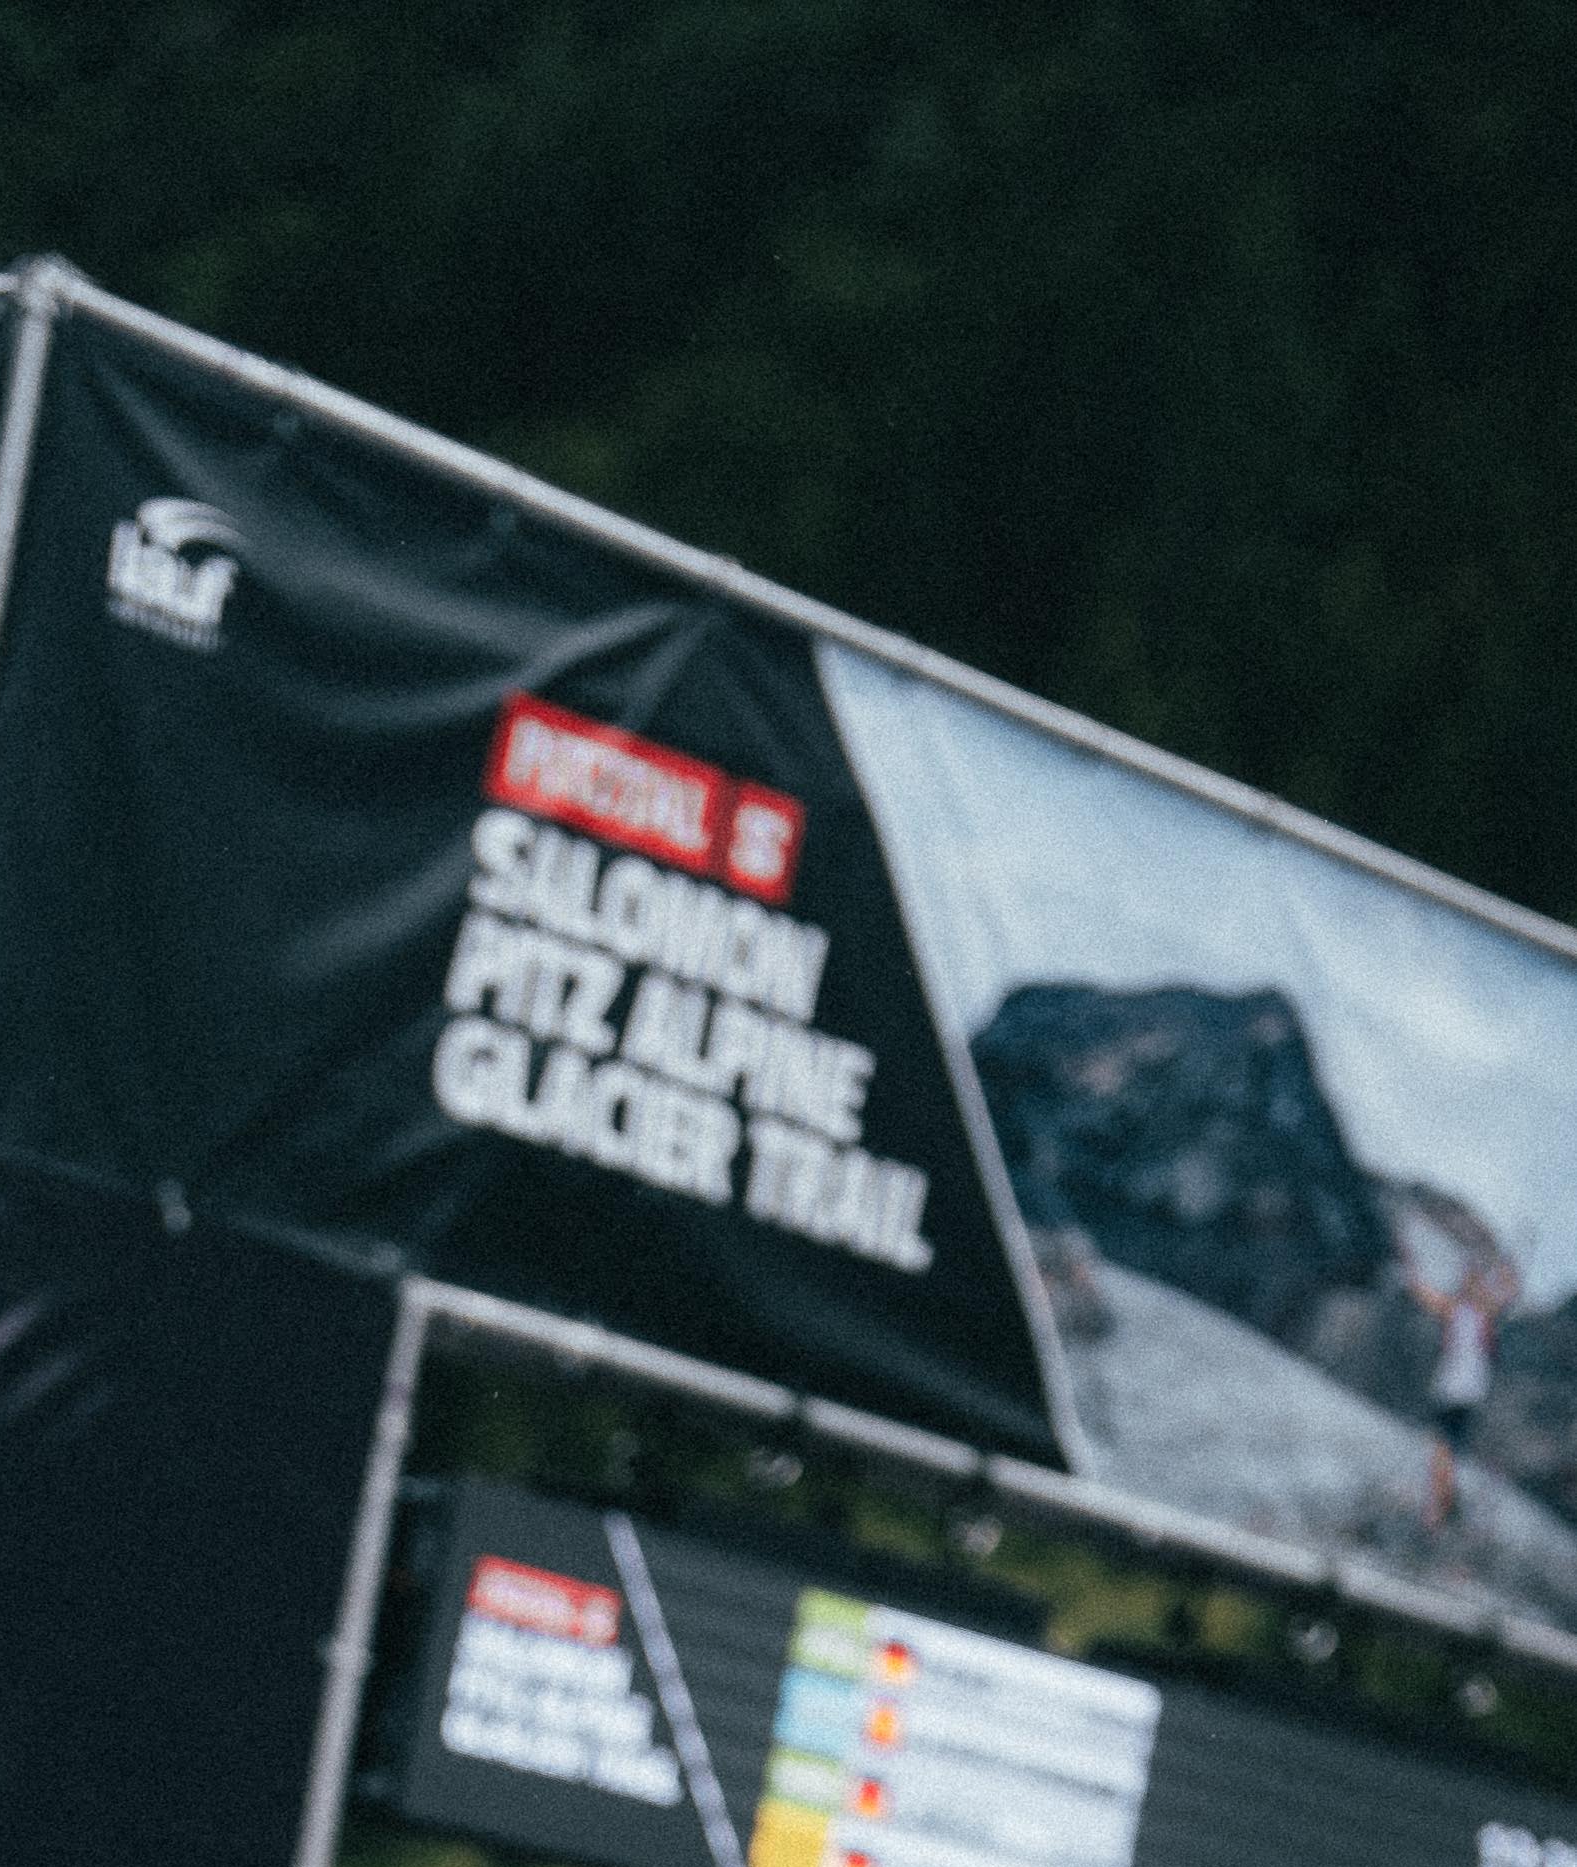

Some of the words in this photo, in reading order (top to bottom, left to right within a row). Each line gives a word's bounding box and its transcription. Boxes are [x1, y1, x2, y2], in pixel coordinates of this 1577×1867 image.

[445, 912, 623, 1058] PITZ
[623, 970, 877, 1144] ALPINE
[469, 806, 829, 1023] SALOMON
[433, 1017, 741, 1203] GLACIER
[746, 1115, 933, 1272] TRAIL
